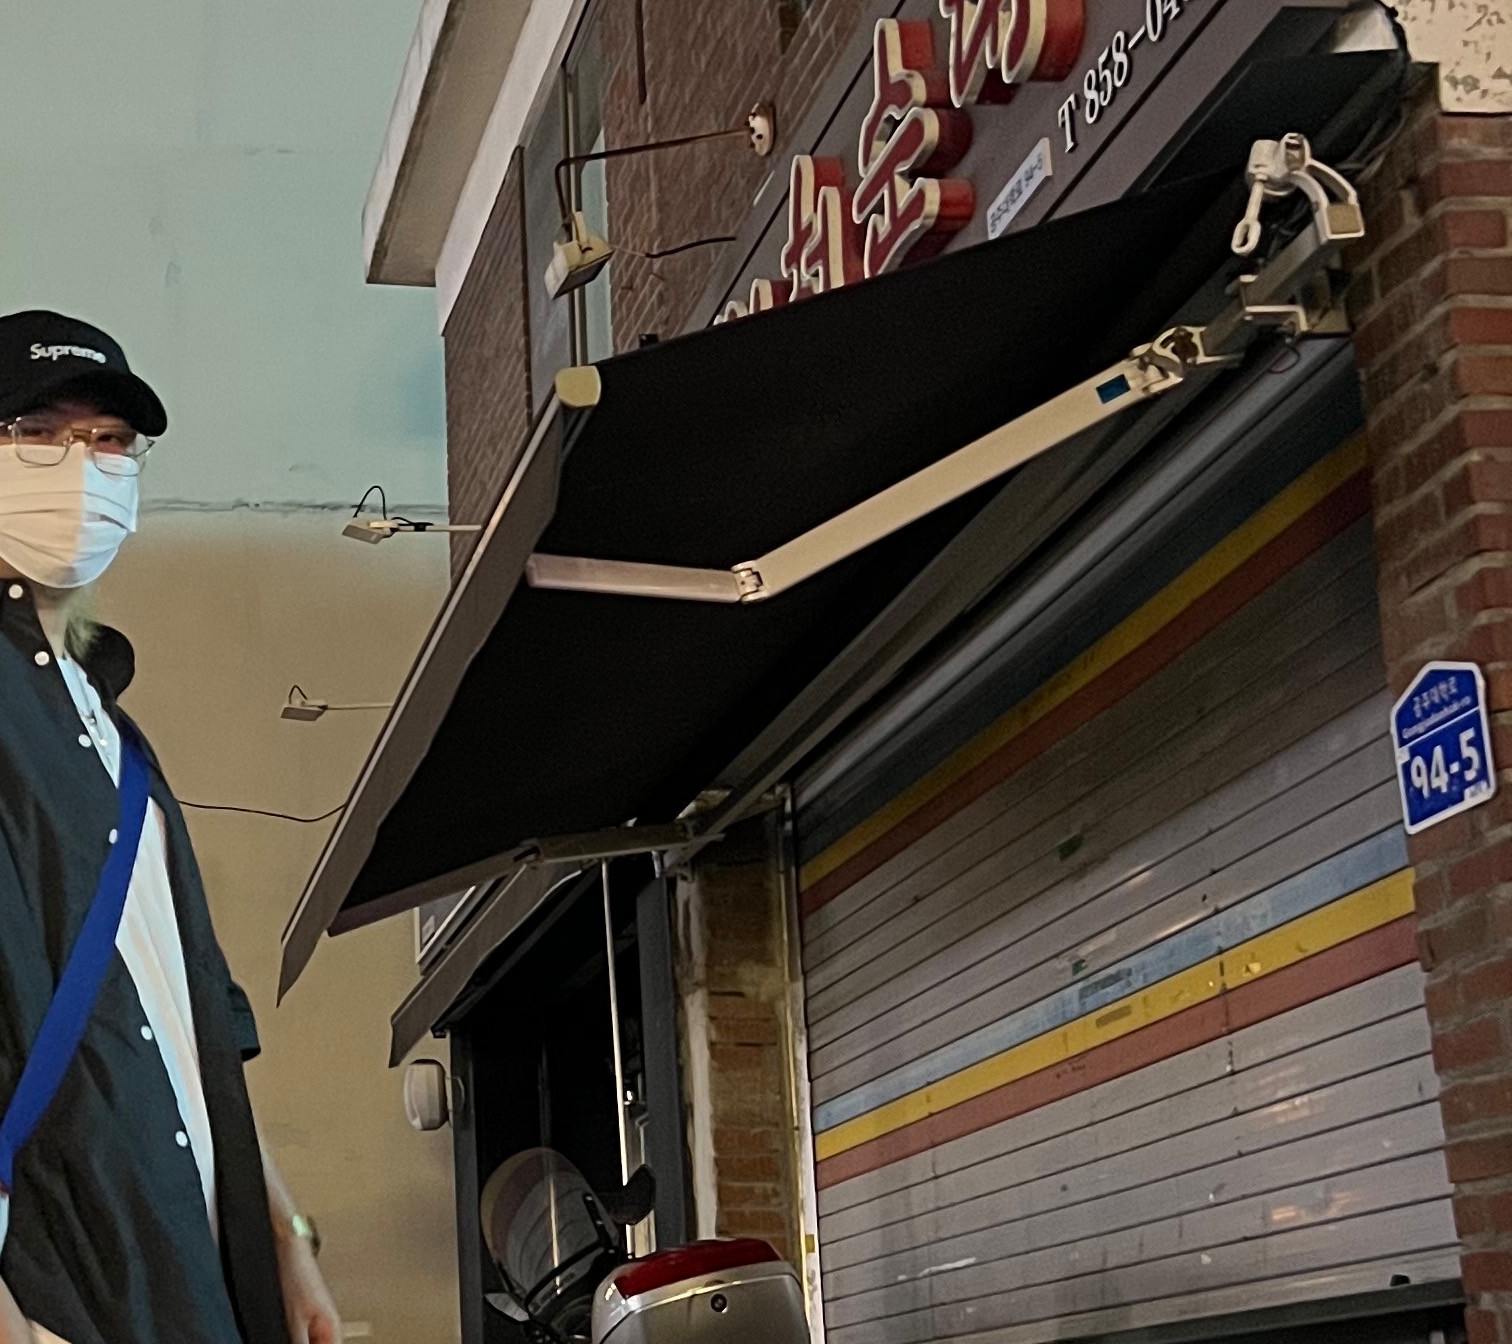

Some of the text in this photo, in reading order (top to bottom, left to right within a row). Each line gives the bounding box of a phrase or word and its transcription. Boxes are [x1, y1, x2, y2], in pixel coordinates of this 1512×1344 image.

[1058, 93, 1078, 153] T
[29, 342, 107, 364] Supreme
[1410, 727, 1480, 799] 94-5
